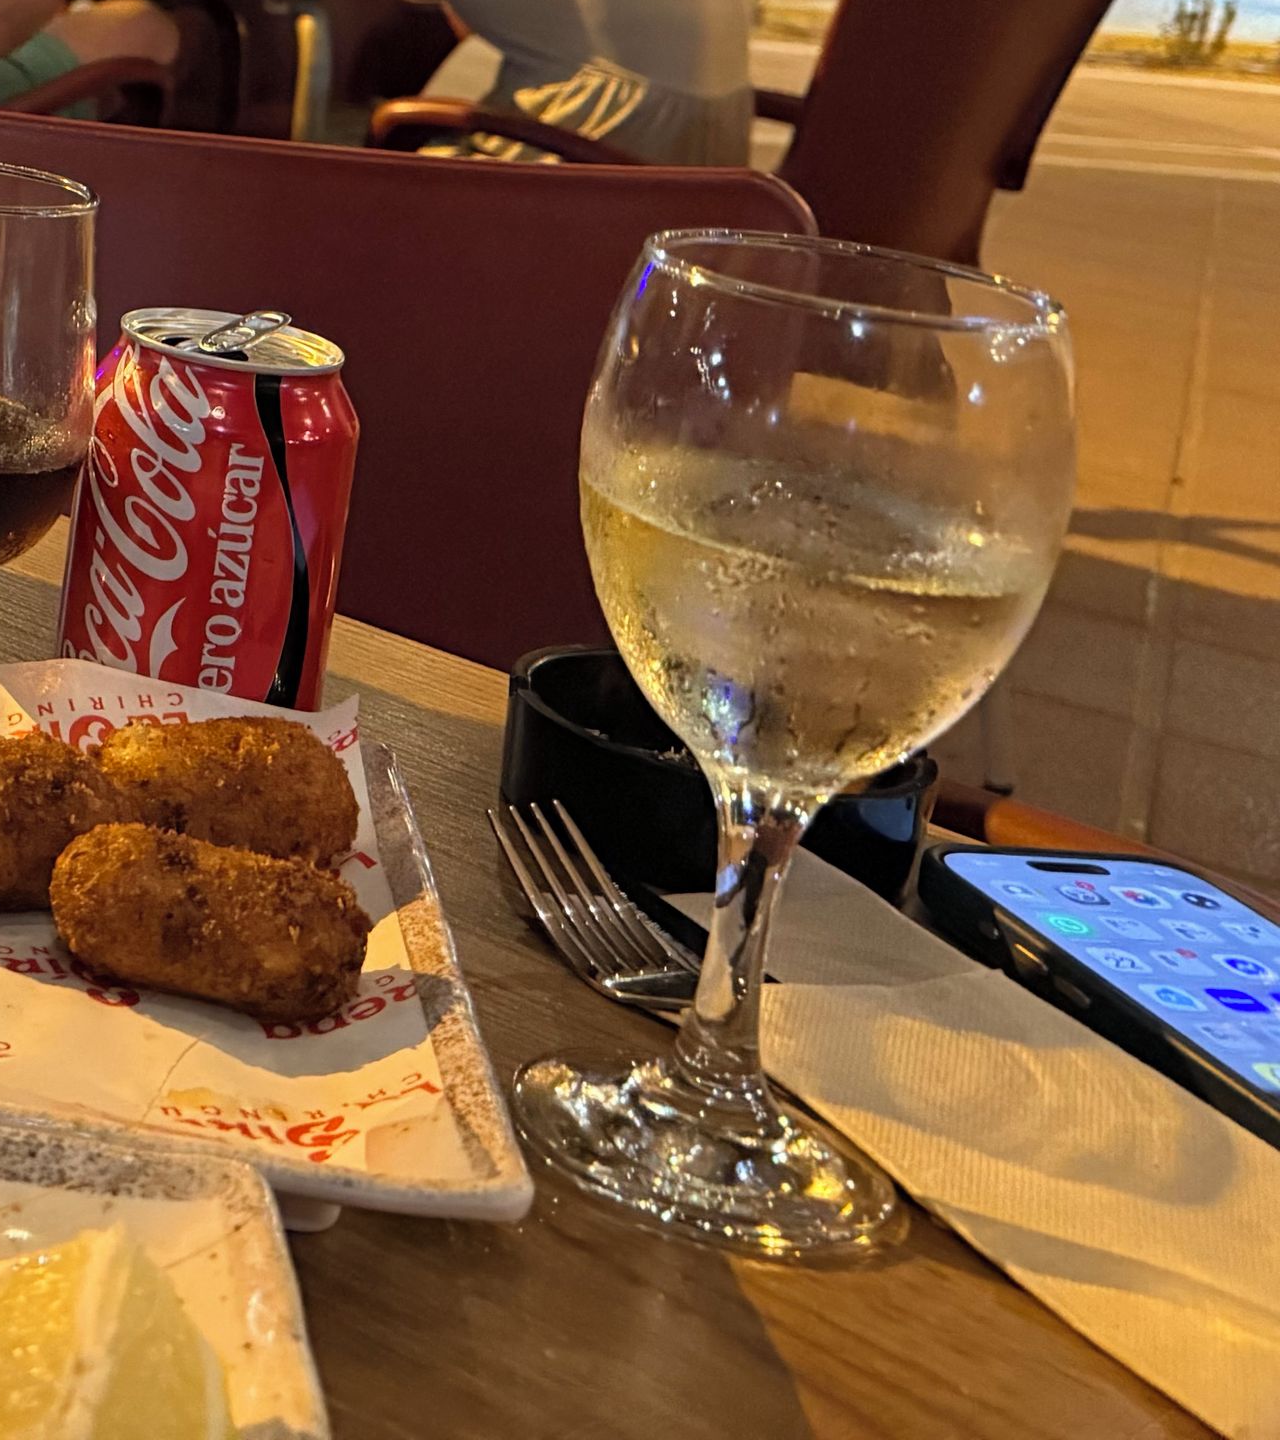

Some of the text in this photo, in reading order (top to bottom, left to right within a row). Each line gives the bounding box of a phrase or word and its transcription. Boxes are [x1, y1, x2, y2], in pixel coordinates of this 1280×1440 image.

[62, 345, 211, 673] ca-Cola
[197, 442, 265, 695] ero azúcar
